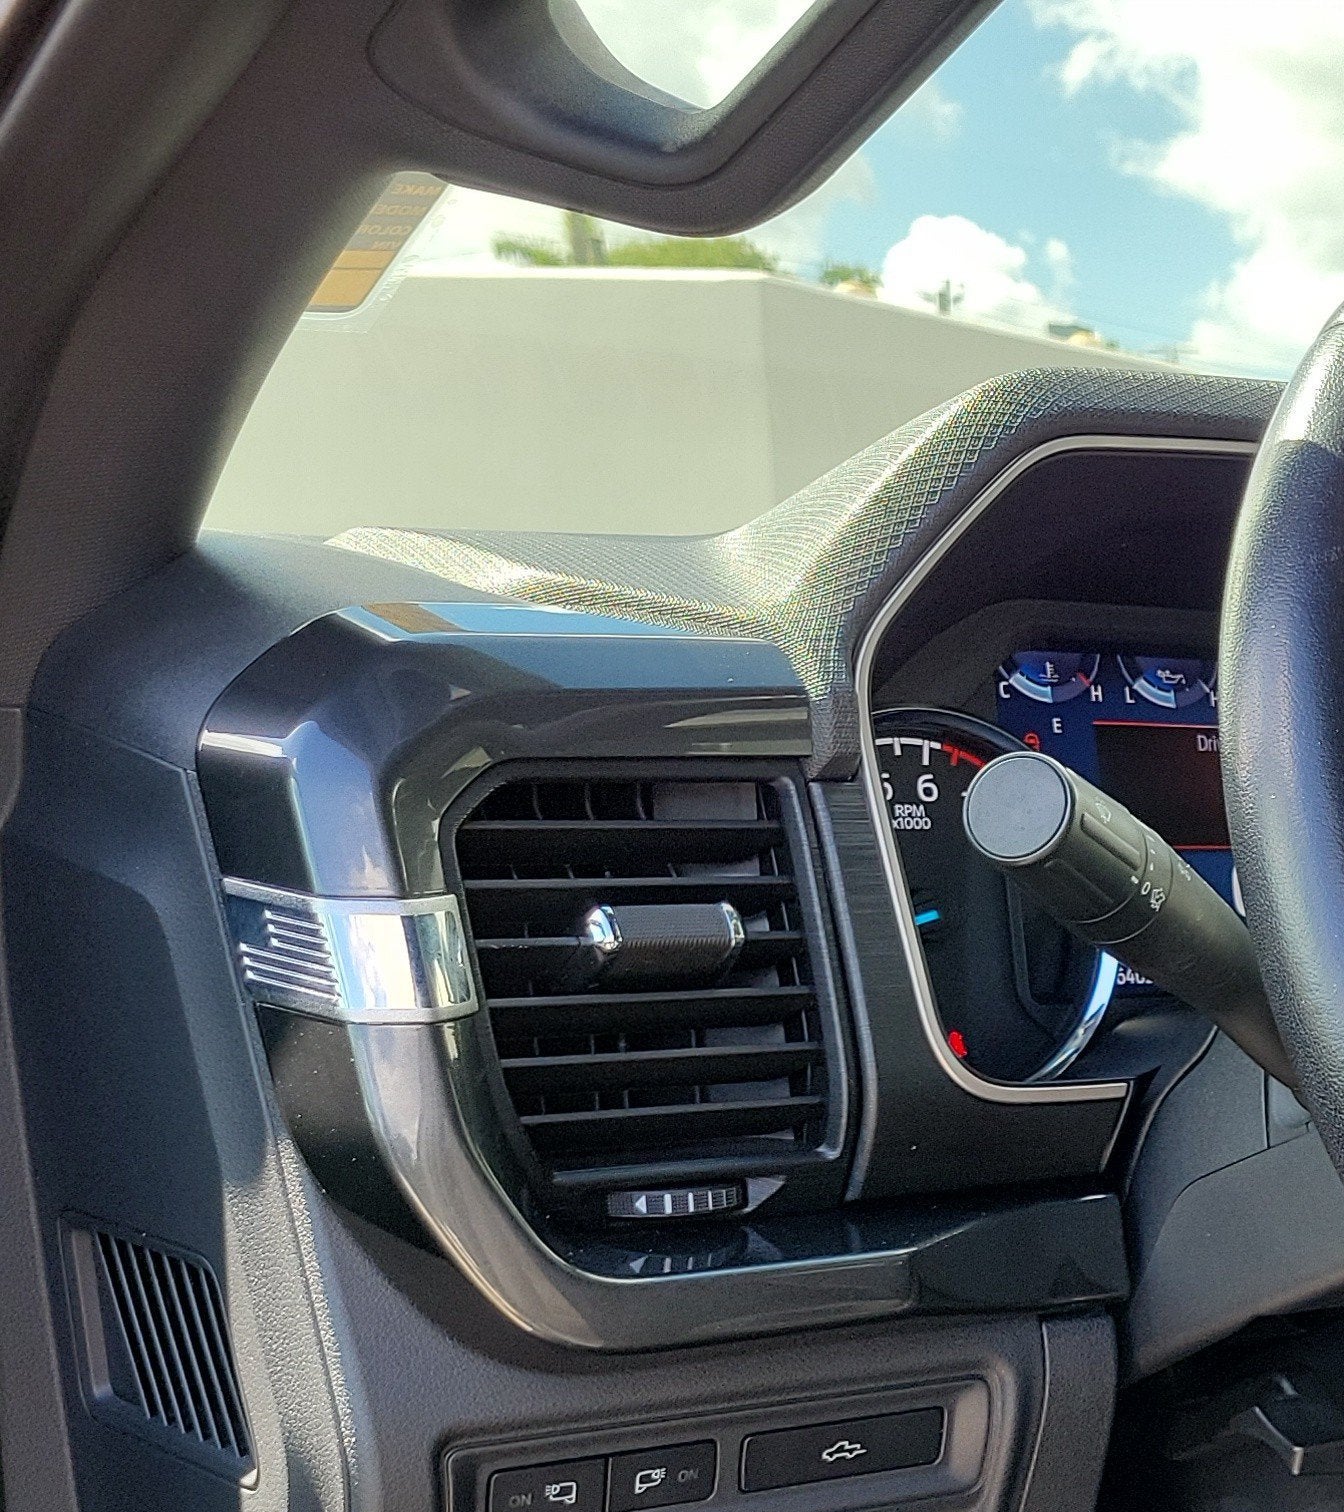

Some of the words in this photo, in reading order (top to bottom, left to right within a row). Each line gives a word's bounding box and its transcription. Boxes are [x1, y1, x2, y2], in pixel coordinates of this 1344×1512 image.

[999, 681, 1011, 699] C
[1090, 685, 1103, 703] H
[1124, 686, 1136, 704] L
[1051, 717, 1063, 734] E
[1196, 734, 1219, 752] Dri
[916, 773, 939, 802] 6
[893, 803, 926, 818] RPM
[678, 1467, 700, 1483] ON
[508, 1492, 533, 1508] ON
